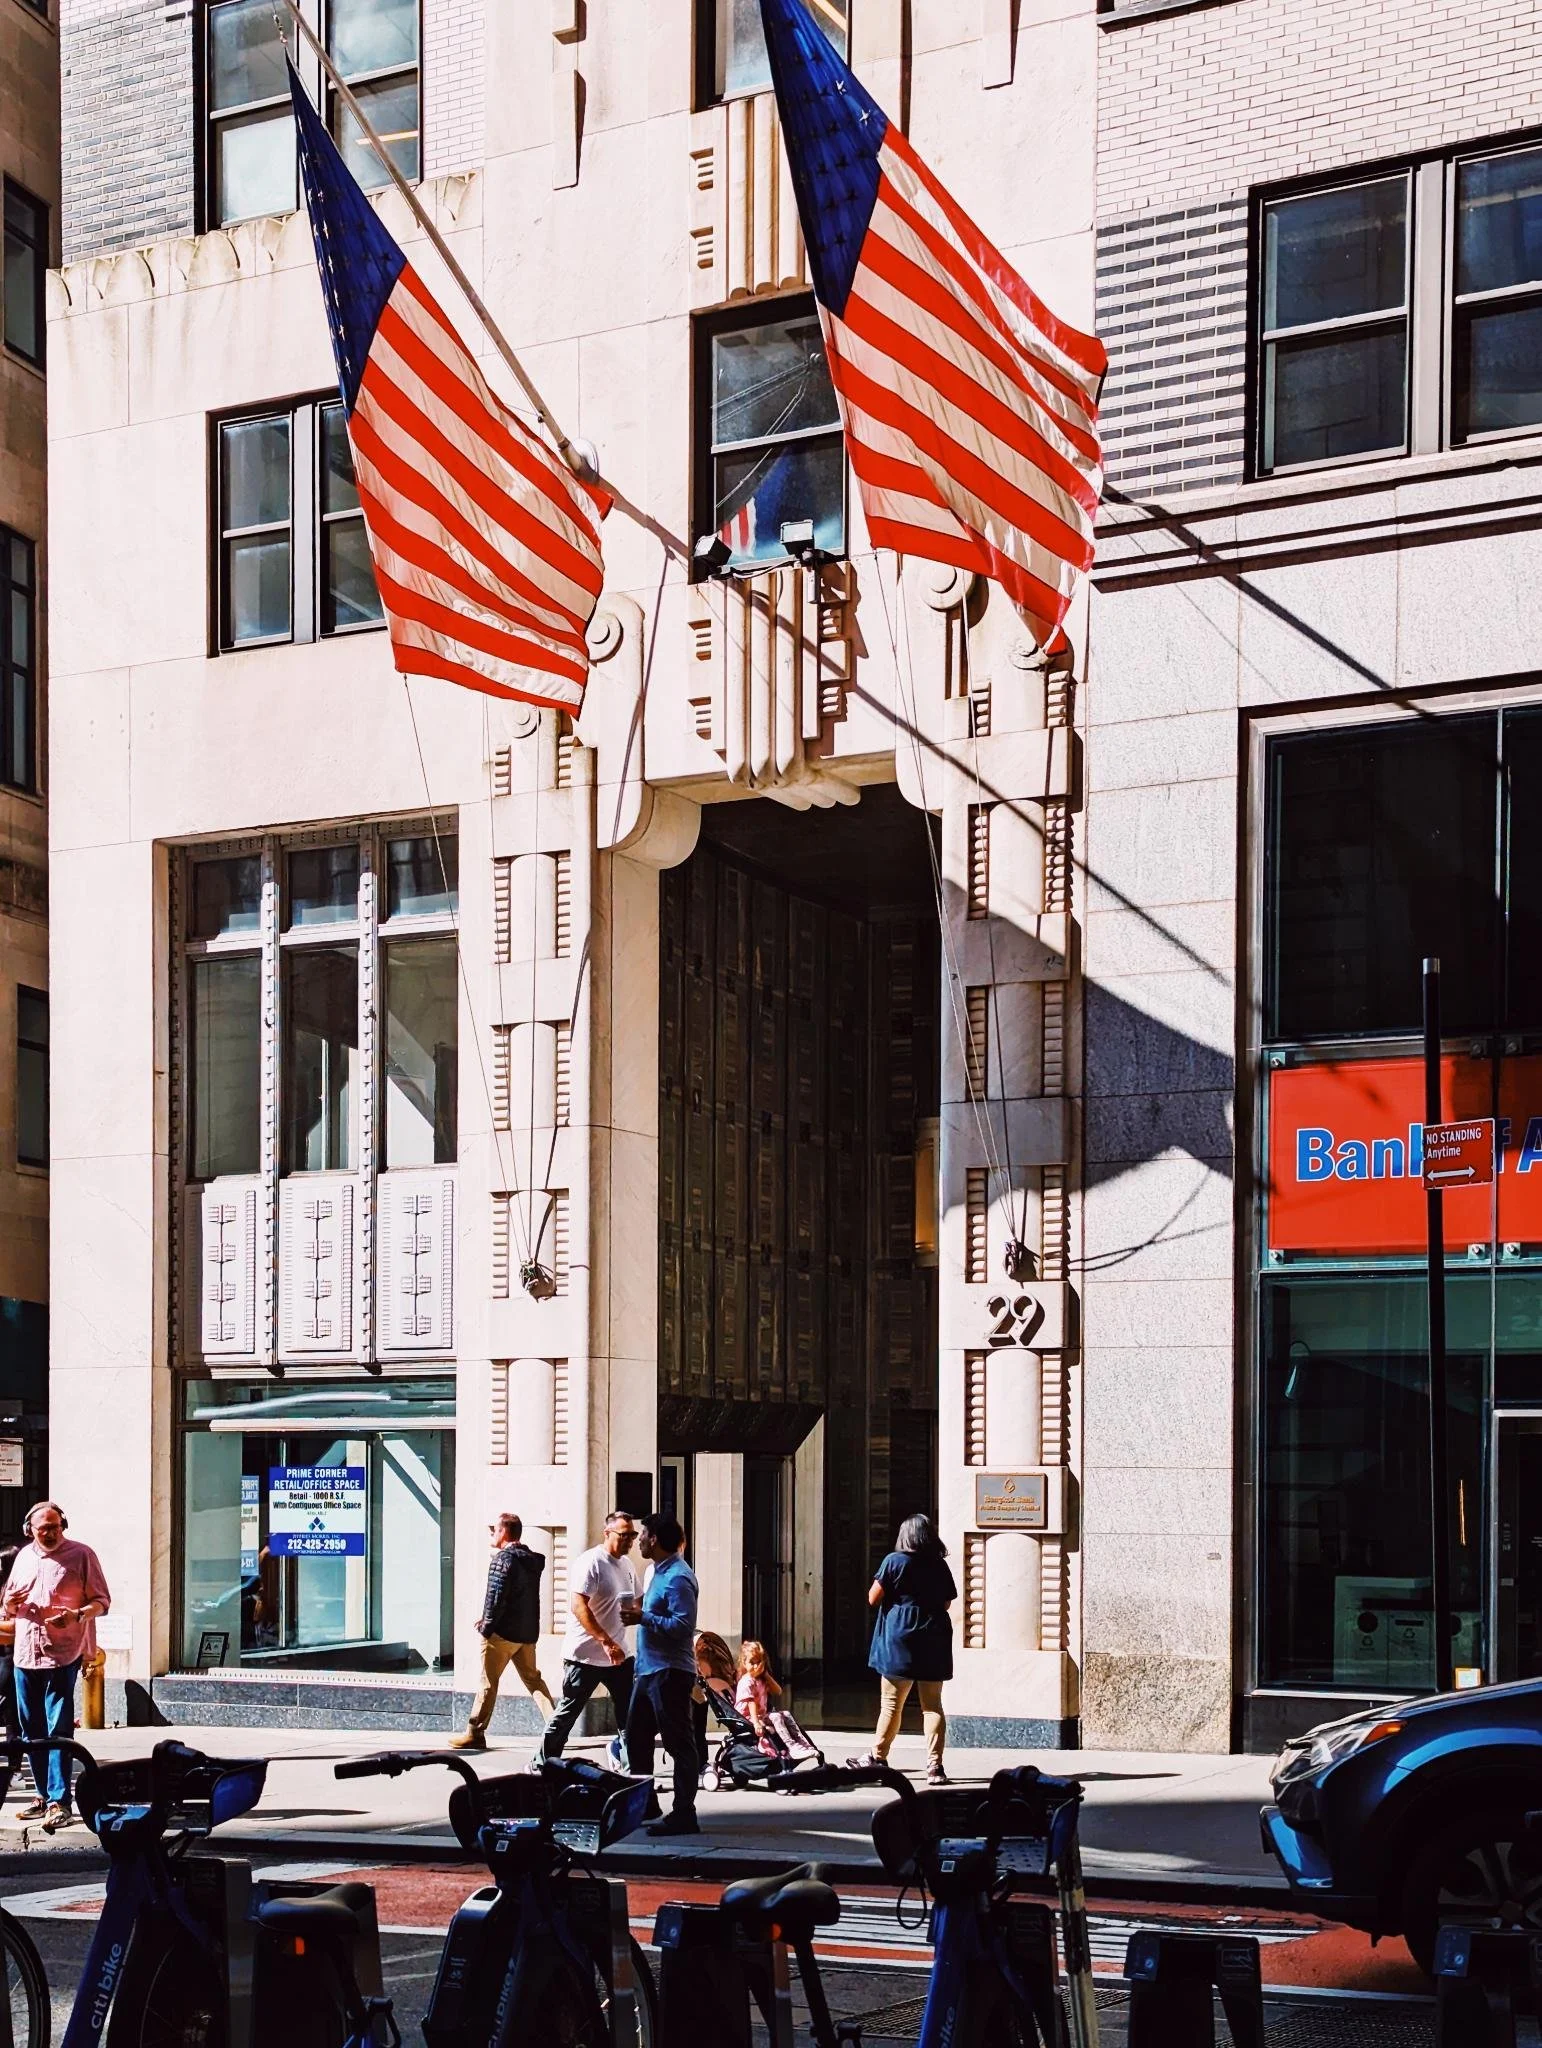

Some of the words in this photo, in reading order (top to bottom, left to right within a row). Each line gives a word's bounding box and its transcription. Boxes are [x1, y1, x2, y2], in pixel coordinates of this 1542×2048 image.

[1426, 1133, 1438, 1145] NO
[1440, 1128, 1482, 1143] STANDING
[1427, 1146, 1461, 1160] Anytime
[986, 1293, 1043, 1346] 29
[286, 1469, 312, 1478] PRIME
[314, 1468, 348, 1478] CORNER
[274, 1480, 332, 1489] RETAIL/OFFICE
[334, 1480, 360, 1489] SPACE
[313, 1492, 328, 1500] 1000
[273, 1501, 287, 1509] With
[288, 1501, 323, 1510] Contiguous
[323, 1501, 341, 1509] Office
[342, 1501, 362, 1510] Space
[98, 1943, 122, 1991] bike
[91, 1993, 109, 2029] citi
